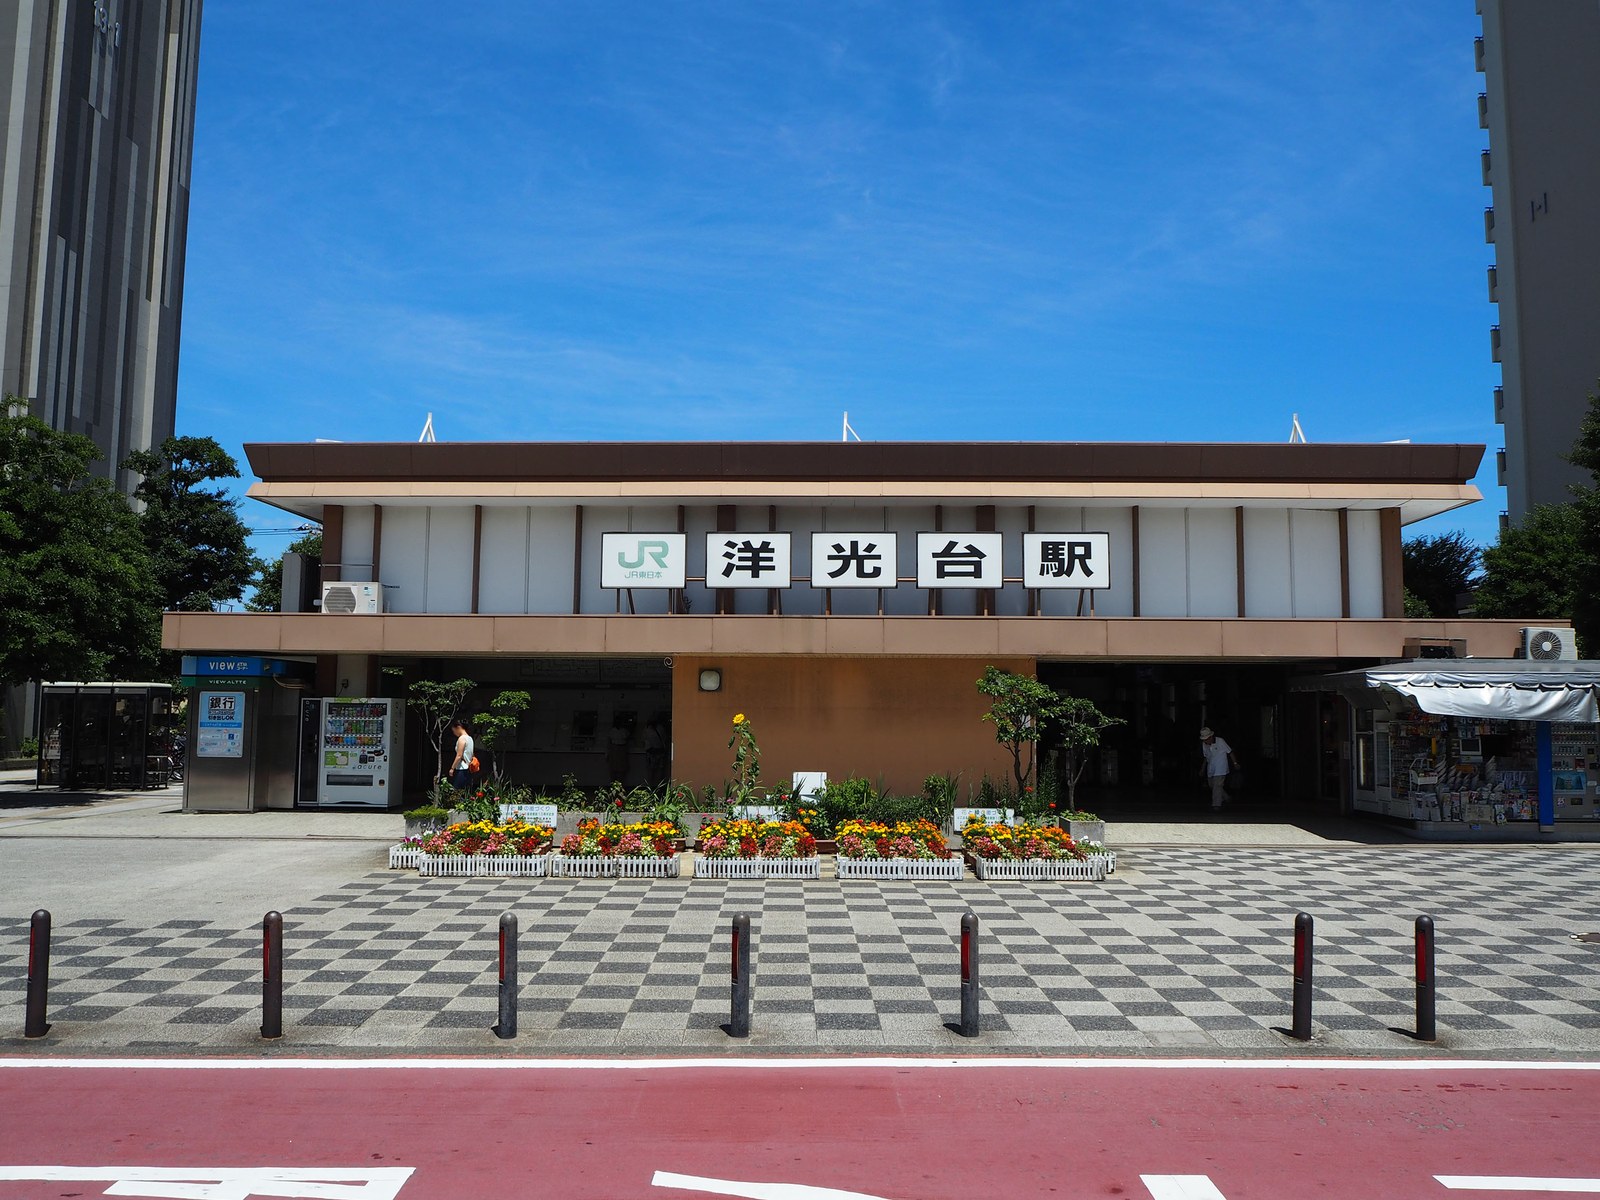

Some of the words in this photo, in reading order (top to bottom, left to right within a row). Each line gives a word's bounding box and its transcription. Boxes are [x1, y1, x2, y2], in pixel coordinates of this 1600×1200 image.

[617, 540, 669, 569] JR
[721, 540, 1094, 579] 洋光台駅
[624, 570, 662, 579] JR東日本
[210, 696, 235, 709] 銀行
